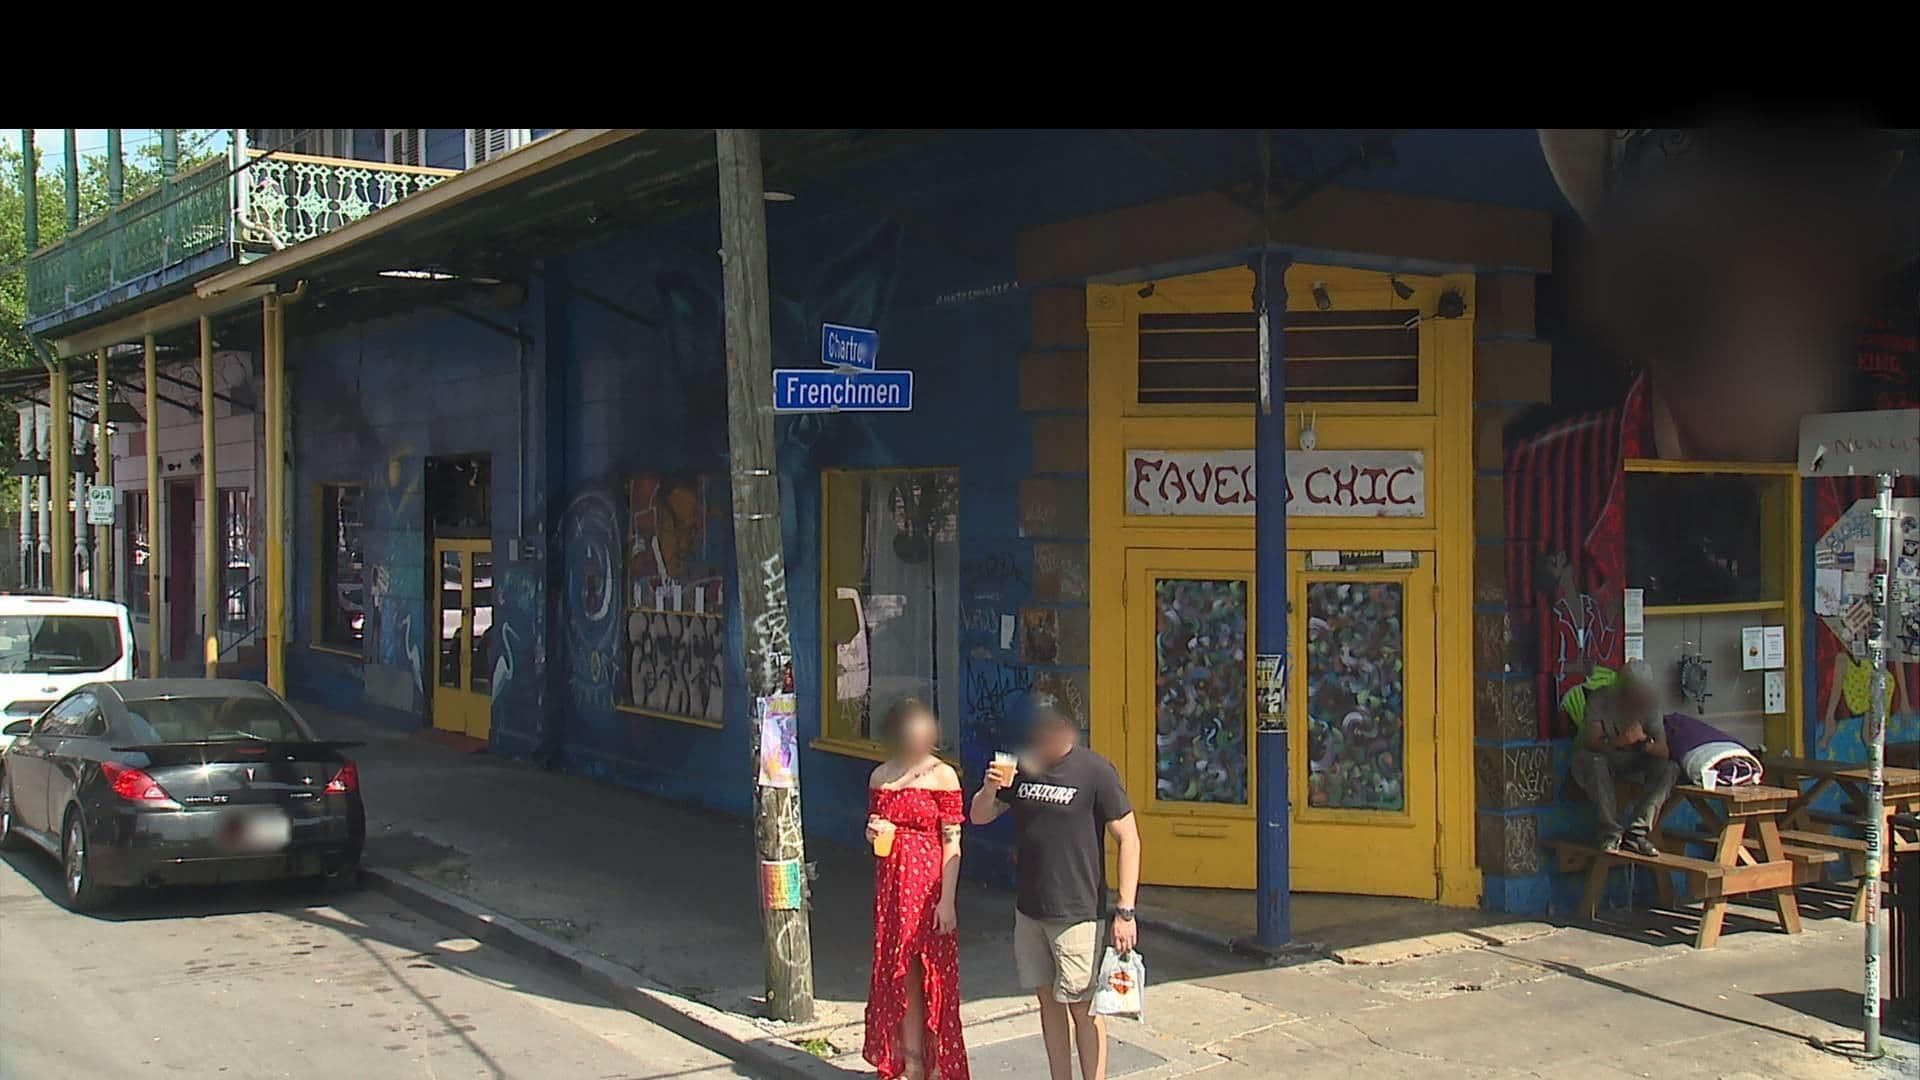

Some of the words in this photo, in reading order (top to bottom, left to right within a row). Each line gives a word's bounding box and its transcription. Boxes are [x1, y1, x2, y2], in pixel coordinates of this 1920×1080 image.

[828, 331, 868, 364] Chartr
[787, 375, 900, 404] Frenchmen
[1304, 464, 1415, 507] CHIC
